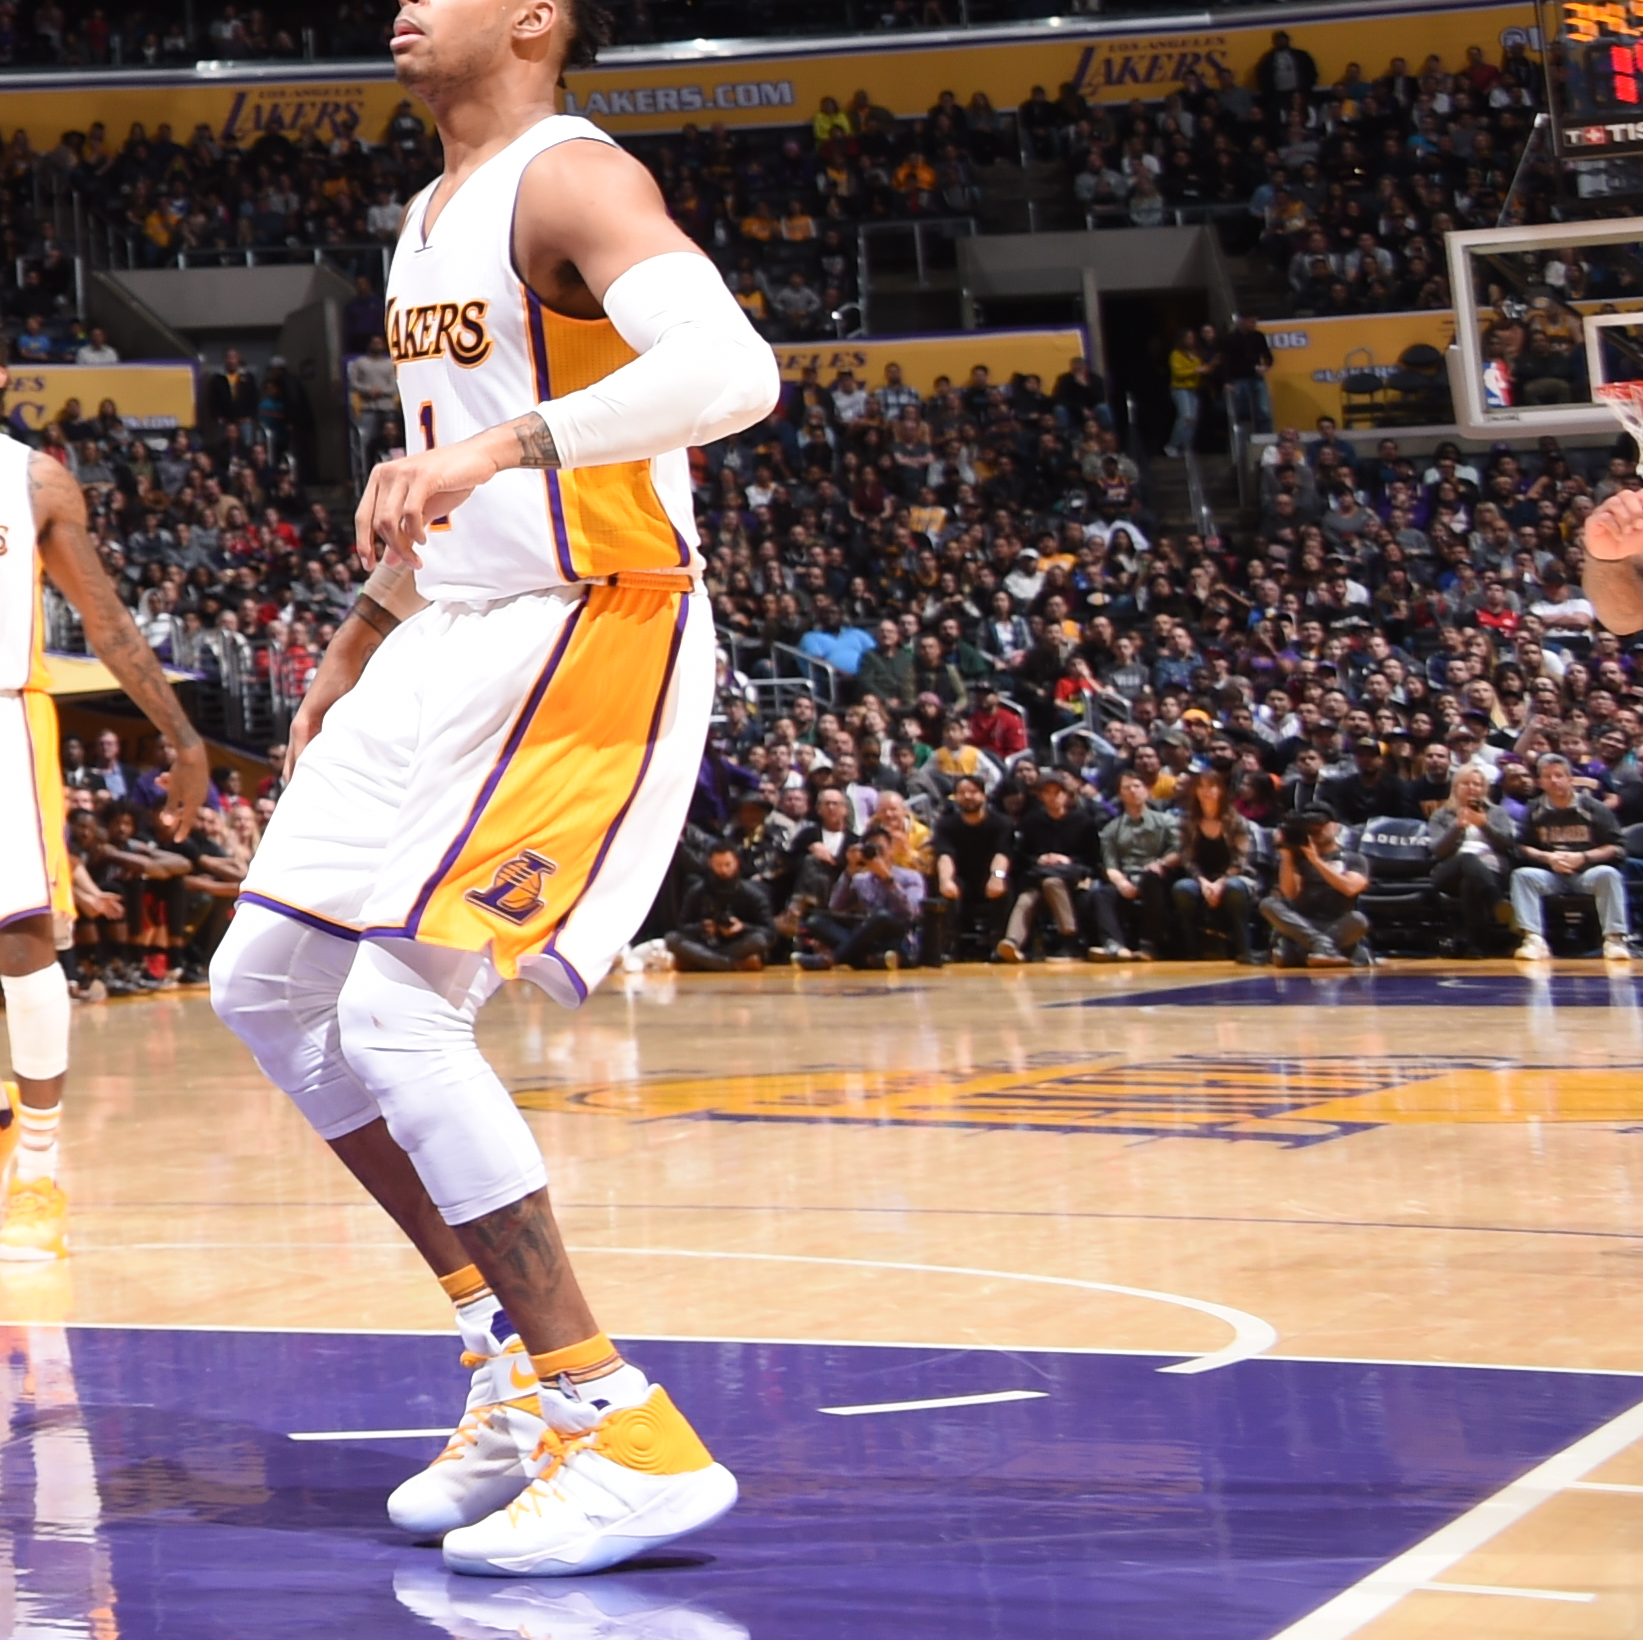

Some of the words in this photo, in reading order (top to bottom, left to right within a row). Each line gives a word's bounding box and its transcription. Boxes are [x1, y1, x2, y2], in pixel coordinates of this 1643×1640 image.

[1072, 45, 1228, 97] LAKERS
[222, 91, 364, 143] LAKERS
[564, 80, 796, 118] LAKERS.COM
